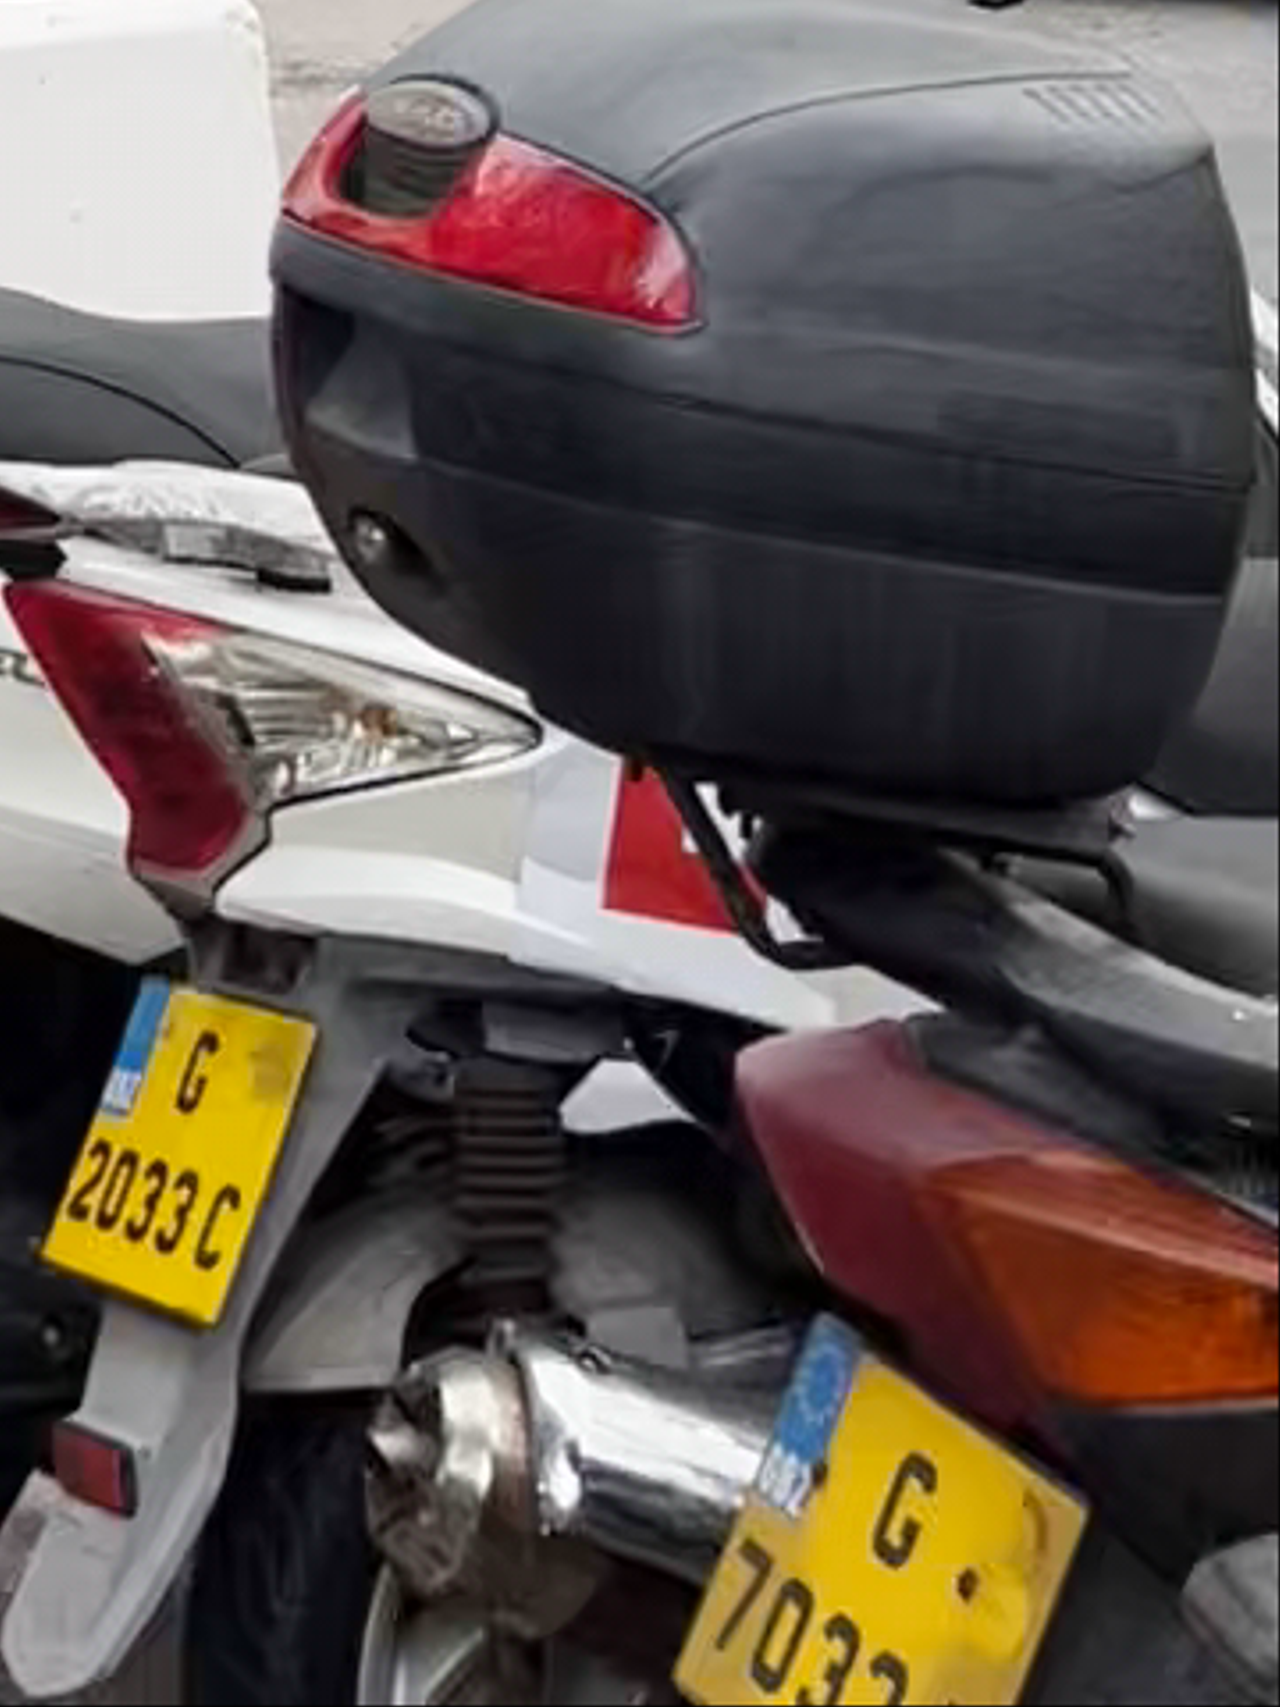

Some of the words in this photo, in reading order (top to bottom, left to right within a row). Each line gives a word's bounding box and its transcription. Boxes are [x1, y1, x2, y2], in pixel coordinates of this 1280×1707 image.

[176, 1031, 220, 1114] G
[66, 1139, 241, 1272] 2033C
[872, 1451, 939, 1570] G
